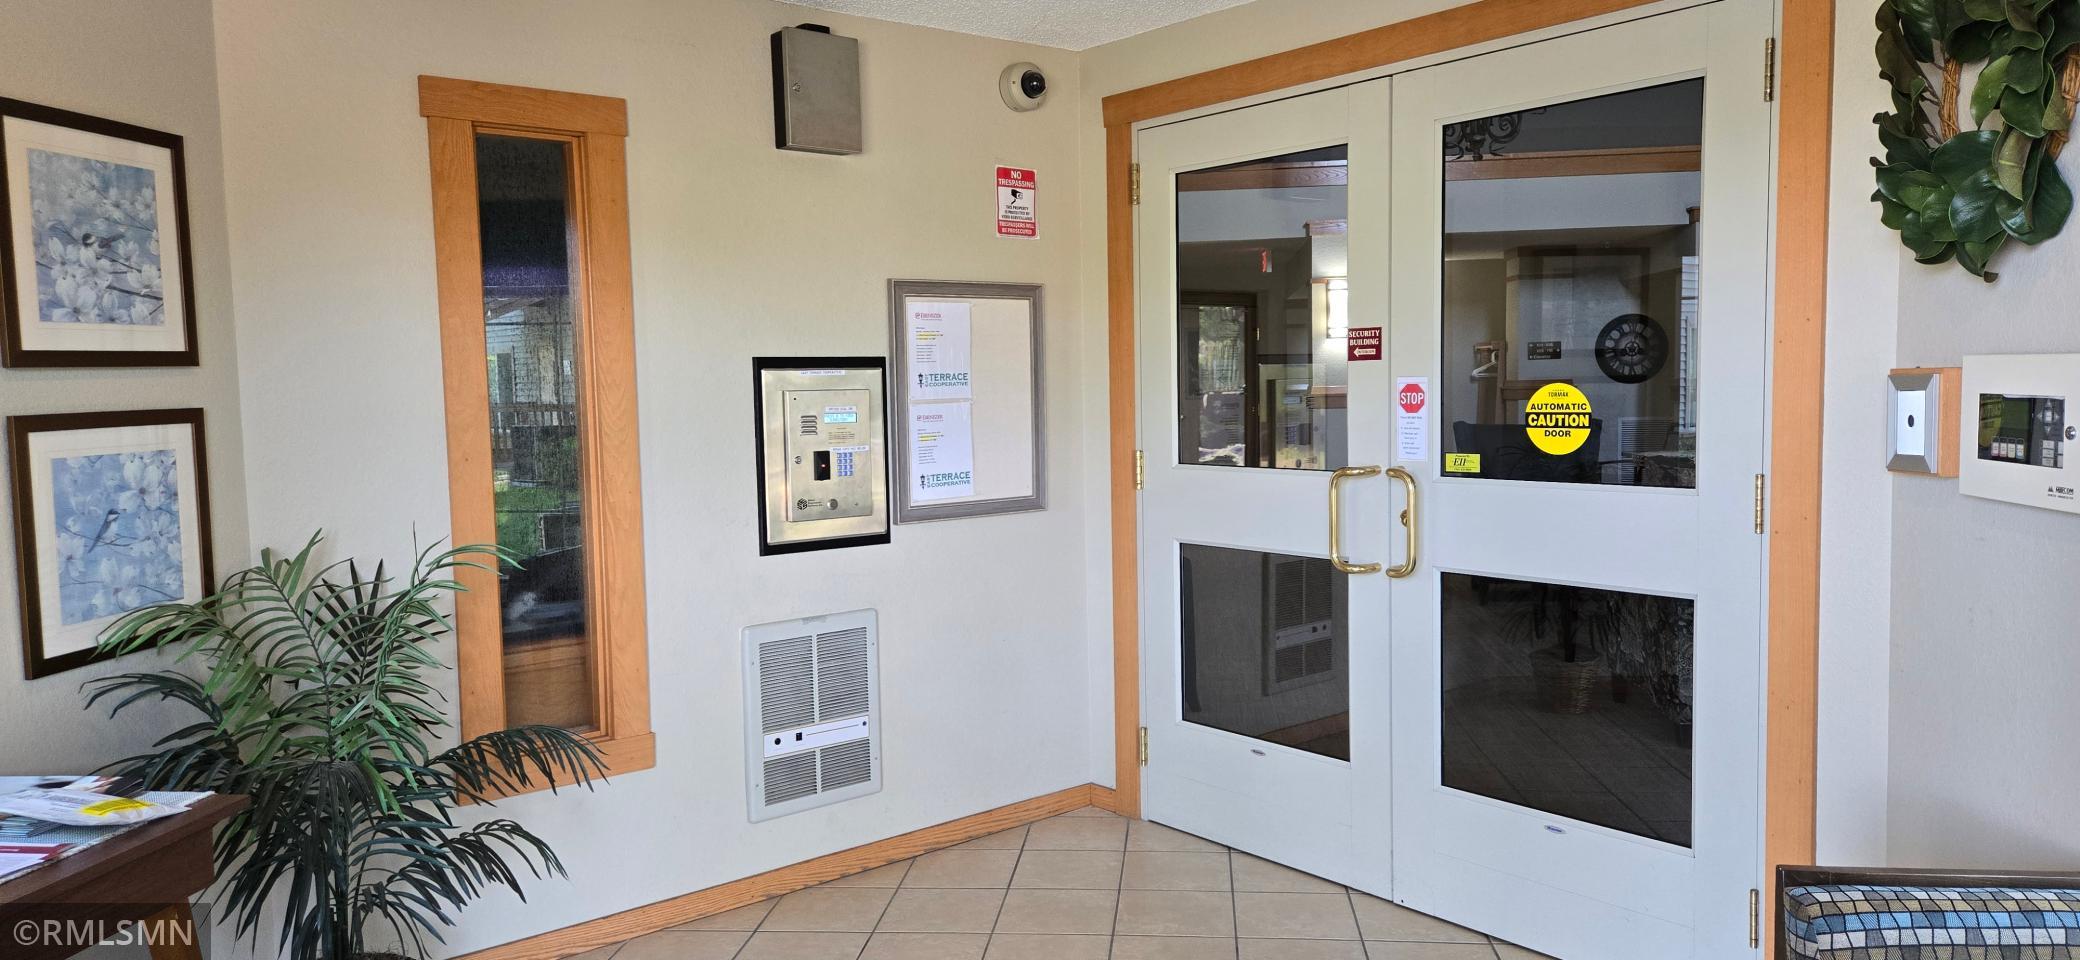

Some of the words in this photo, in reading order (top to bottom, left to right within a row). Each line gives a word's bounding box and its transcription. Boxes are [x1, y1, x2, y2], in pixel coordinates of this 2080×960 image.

[1010, 170, 1022, 179] NO
[998, 178, 1035, 188] TRESPASSING
[1348, 329, 1380, 338] SECURITY
[1349, 338, 1379, 346] BUILDING
[929, 372, 969, 381] TERRACE
[1400, 392, 1424, 405] STOP
[1530, 402, 1587, 411] AUTOMATIC
[1527, 414, 1590, 427] CAUTION
[1544, 429, 1571, 438] DOOR
[930, 471, 971, 482] TERRACE
[931, 479, 971, 488] COOPERATIVE
